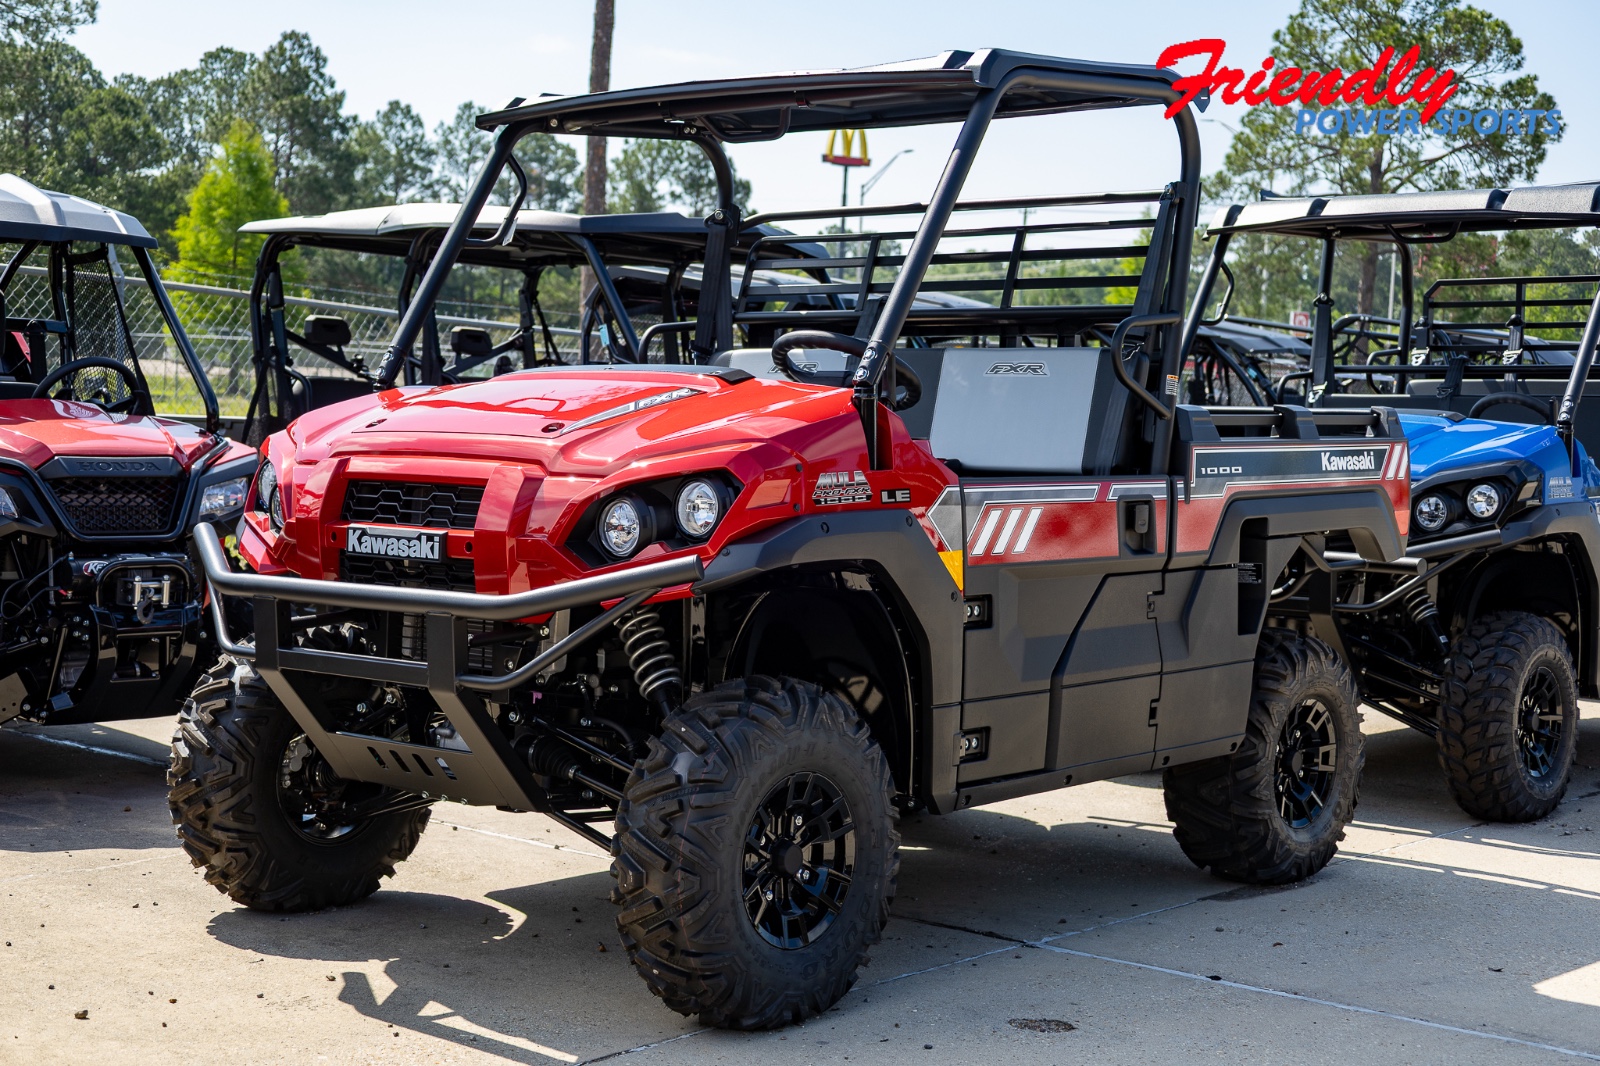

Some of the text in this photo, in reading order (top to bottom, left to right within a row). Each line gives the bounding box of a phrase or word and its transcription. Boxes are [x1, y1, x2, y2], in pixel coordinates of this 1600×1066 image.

[768, 362, 819, 374] FR
[985, 362, 1047, 375] FXR
[76, 461, 161, 471] HONDA
[1201, 451, 1375, 474] 1000 Kawasaki
[815, 470, 869, 489] MULE
[819, 495, 868, 505] 1000
[881, 489, 911, 503] LE
[347, 529, 440, 560] Kawasaki
[87, 562, 106, 574] KF
